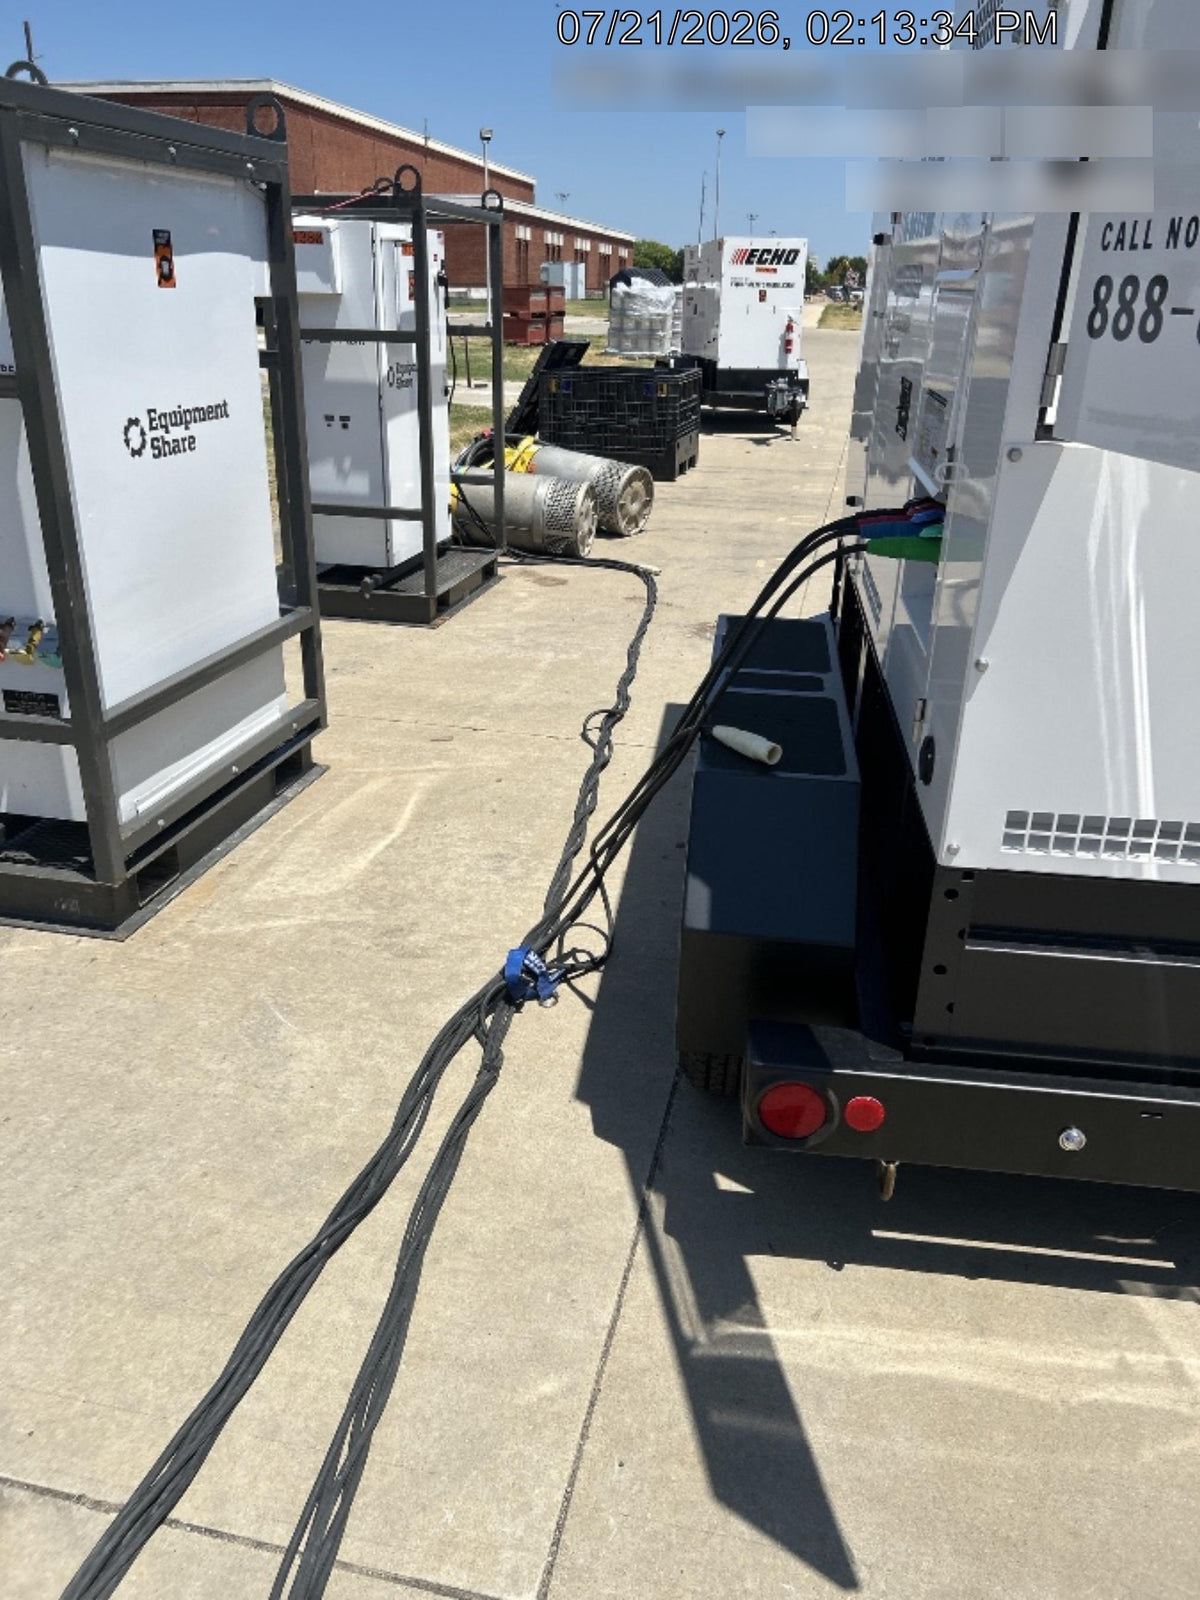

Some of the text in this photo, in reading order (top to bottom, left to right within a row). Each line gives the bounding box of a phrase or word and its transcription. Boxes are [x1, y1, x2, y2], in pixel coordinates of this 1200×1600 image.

[1101, 219, 1153, 251] CALL
[744, 248, 800, 265] ECHO
[1087, 274, 1200, 344] 888-
[147, 399, 230, 434] Equipment
[150, 434, 197, 459] Share
